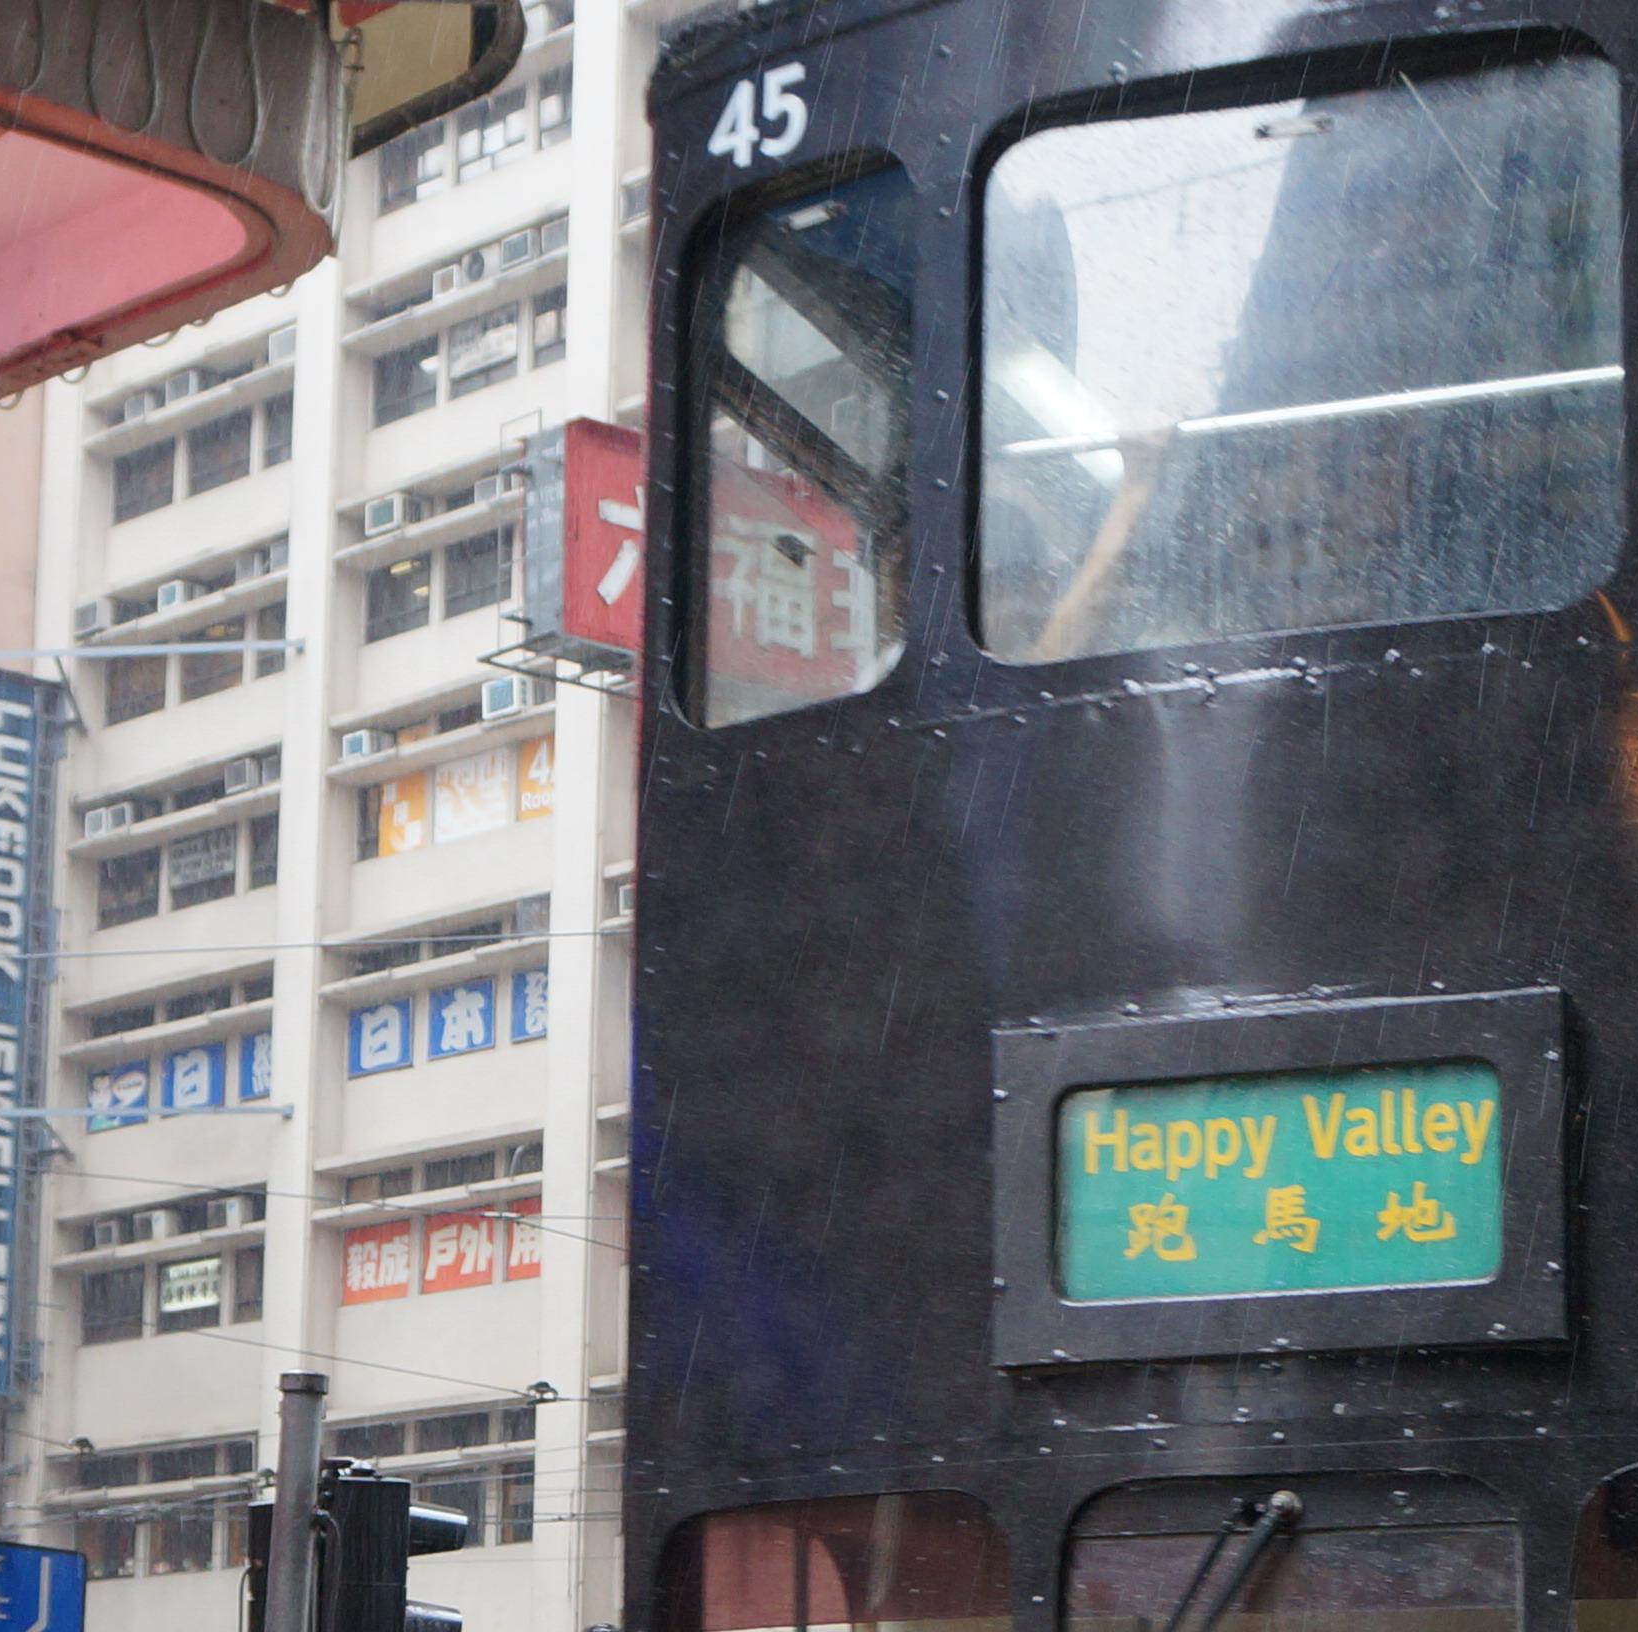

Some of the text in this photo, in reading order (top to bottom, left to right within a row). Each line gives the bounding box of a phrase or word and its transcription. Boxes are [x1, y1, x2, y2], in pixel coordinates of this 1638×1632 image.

[709, 63, 807, 167] 45
[1084, 1088, 1496, 1181] Happy Valley
[1124, 1181, 1458, 1264] 跑馬地
